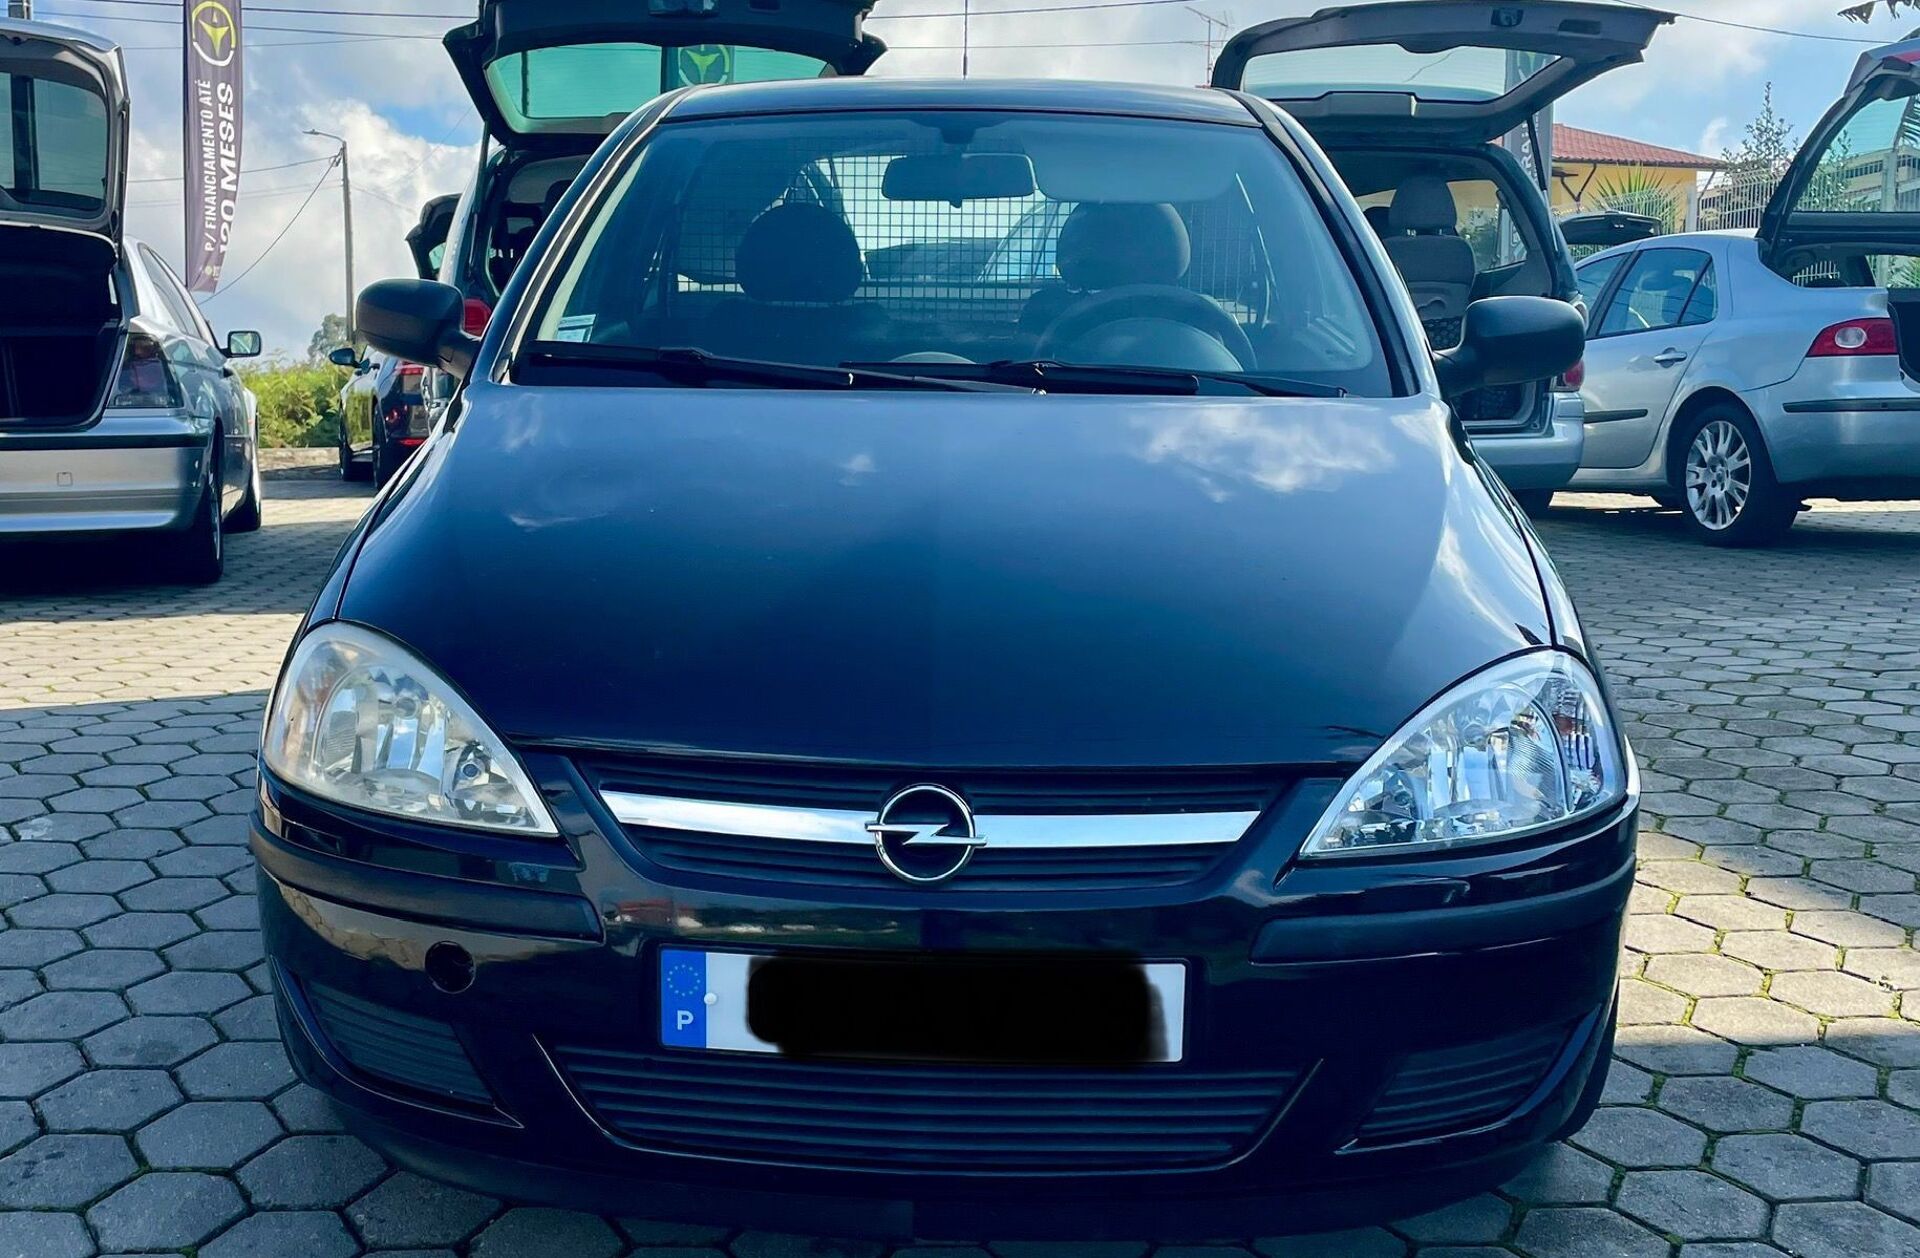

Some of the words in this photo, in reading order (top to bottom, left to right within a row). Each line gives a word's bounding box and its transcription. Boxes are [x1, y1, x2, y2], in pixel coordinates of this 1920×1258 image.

[194, 79, 213, 107] ATÉ
[216, 82, 237, 191] MESES
[200, 109, 217, 229] FINANCIAMENTO
[204, 232, 216, 252] P/
[677, 1010, 694, 1030] P
